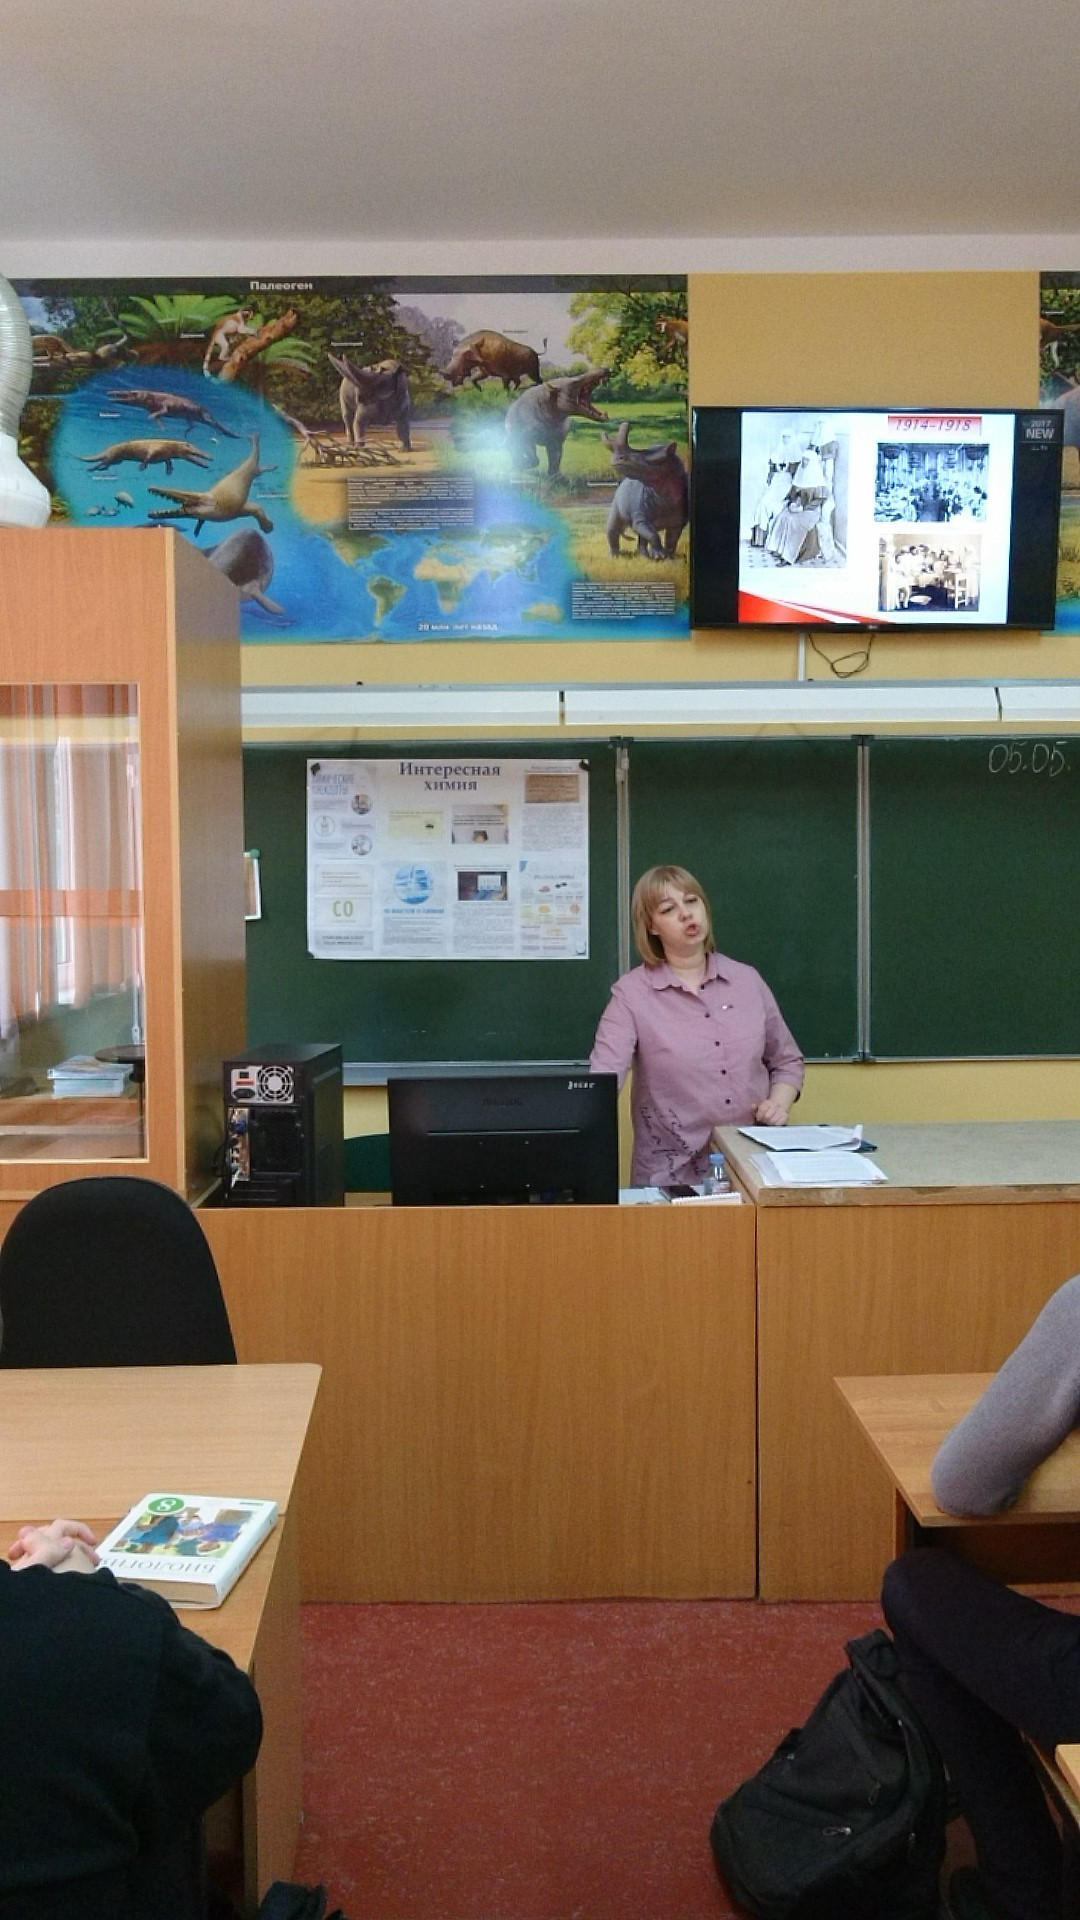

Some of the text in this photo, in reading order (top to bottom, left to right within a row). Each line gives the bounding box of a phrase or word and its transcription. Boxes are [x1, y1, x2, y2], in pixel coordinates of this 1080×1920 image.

[249, 281, 313, 291] Палеоген
[896, 419, 972, 431] 1914-1918
[1026, 428, 1054, 439] NEW
[400, 762, 500, 779] Интересная
[424, 781, 478, 790] химия
[156, 1499, 177, 1511] 8
